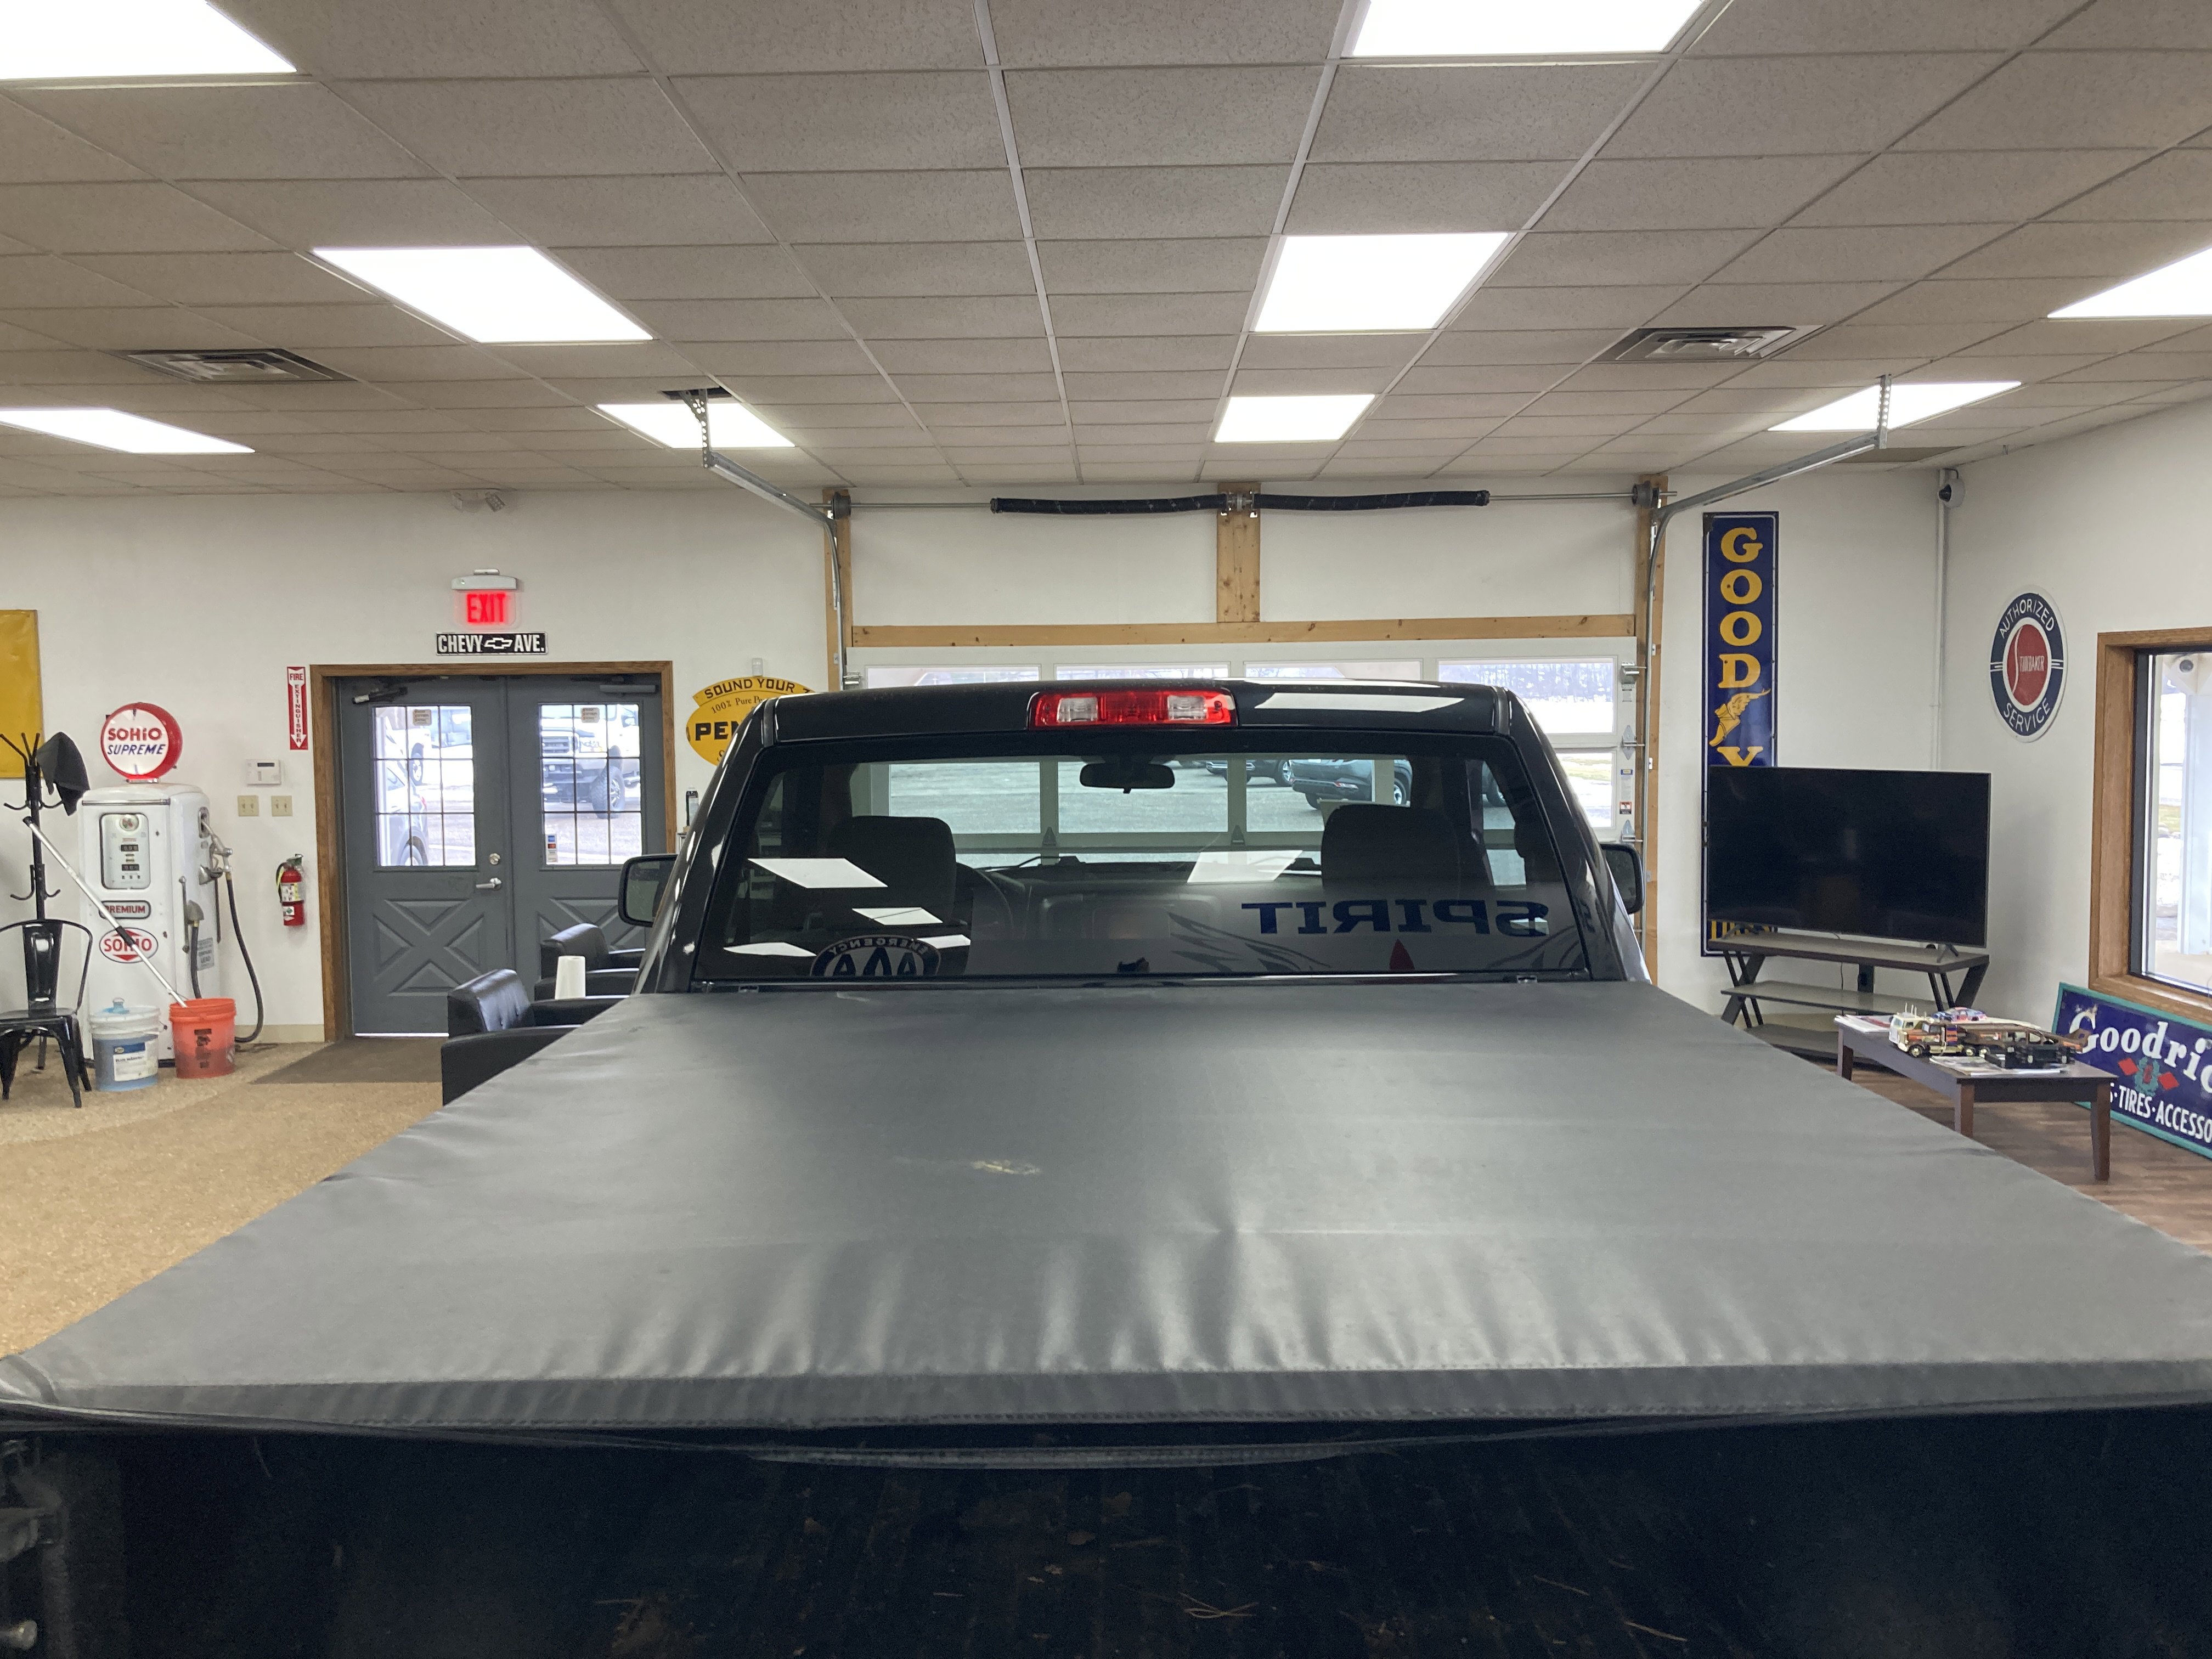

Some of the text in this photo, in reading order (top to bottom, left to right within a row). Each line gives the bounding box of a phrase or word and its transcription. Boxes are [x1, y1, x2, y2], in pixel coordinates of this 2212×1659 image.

[467, 594, 506, 622] EXIT
[2000, 599, 2055, 639] AUTHORIZED
[438, 634, 544, 652] CHEVY AVE.
[704, 679, 795, 699] SOUND YOUR
[711, 700, 731, 713] 100%
[736, 695, 752, 706] Pure
[2004, 697, 2051, 732] SERVICE
[108, 744, 166, 755] SUPREME
[2119, 1085, 2152, 1118] TIRES
